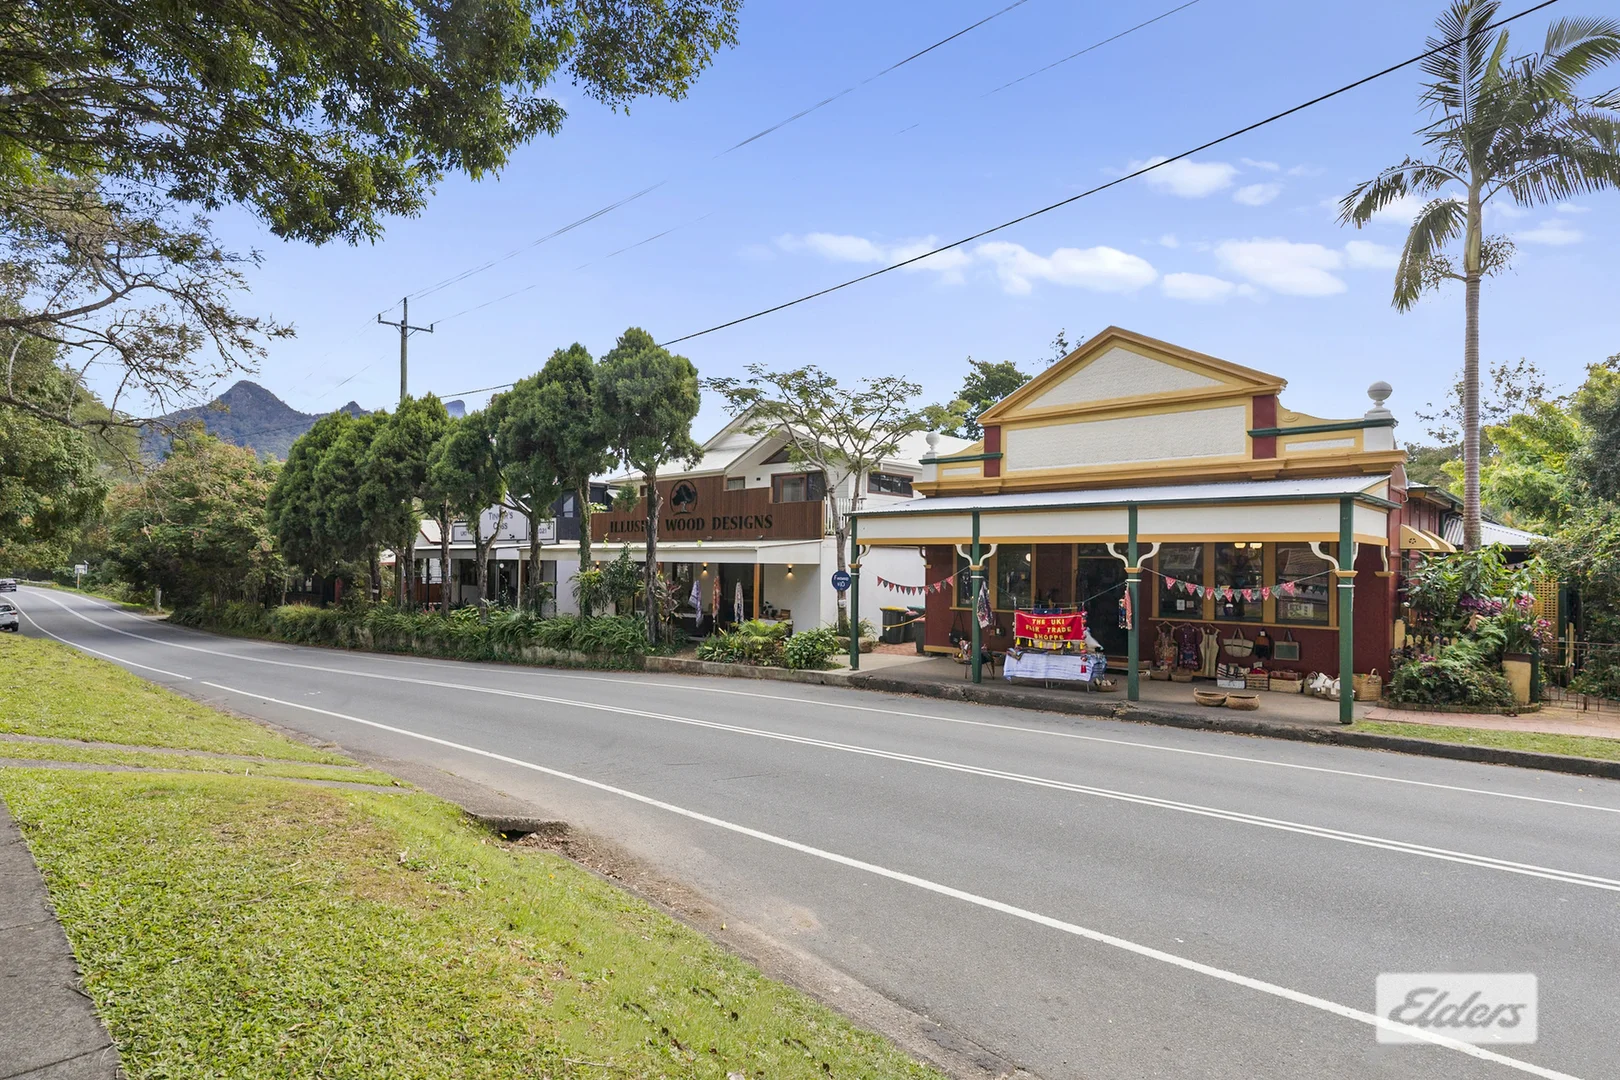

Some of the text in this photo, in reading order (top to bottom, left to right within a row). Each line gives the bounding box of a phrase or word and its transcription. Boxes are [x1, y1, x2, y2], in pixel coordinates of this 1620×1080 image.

[488, 511, 514, 520] TINR'S
[493, 521, 508, 530] CSS
[610, 514, 773, 533] ILLUSI WOOD DESIGNS
